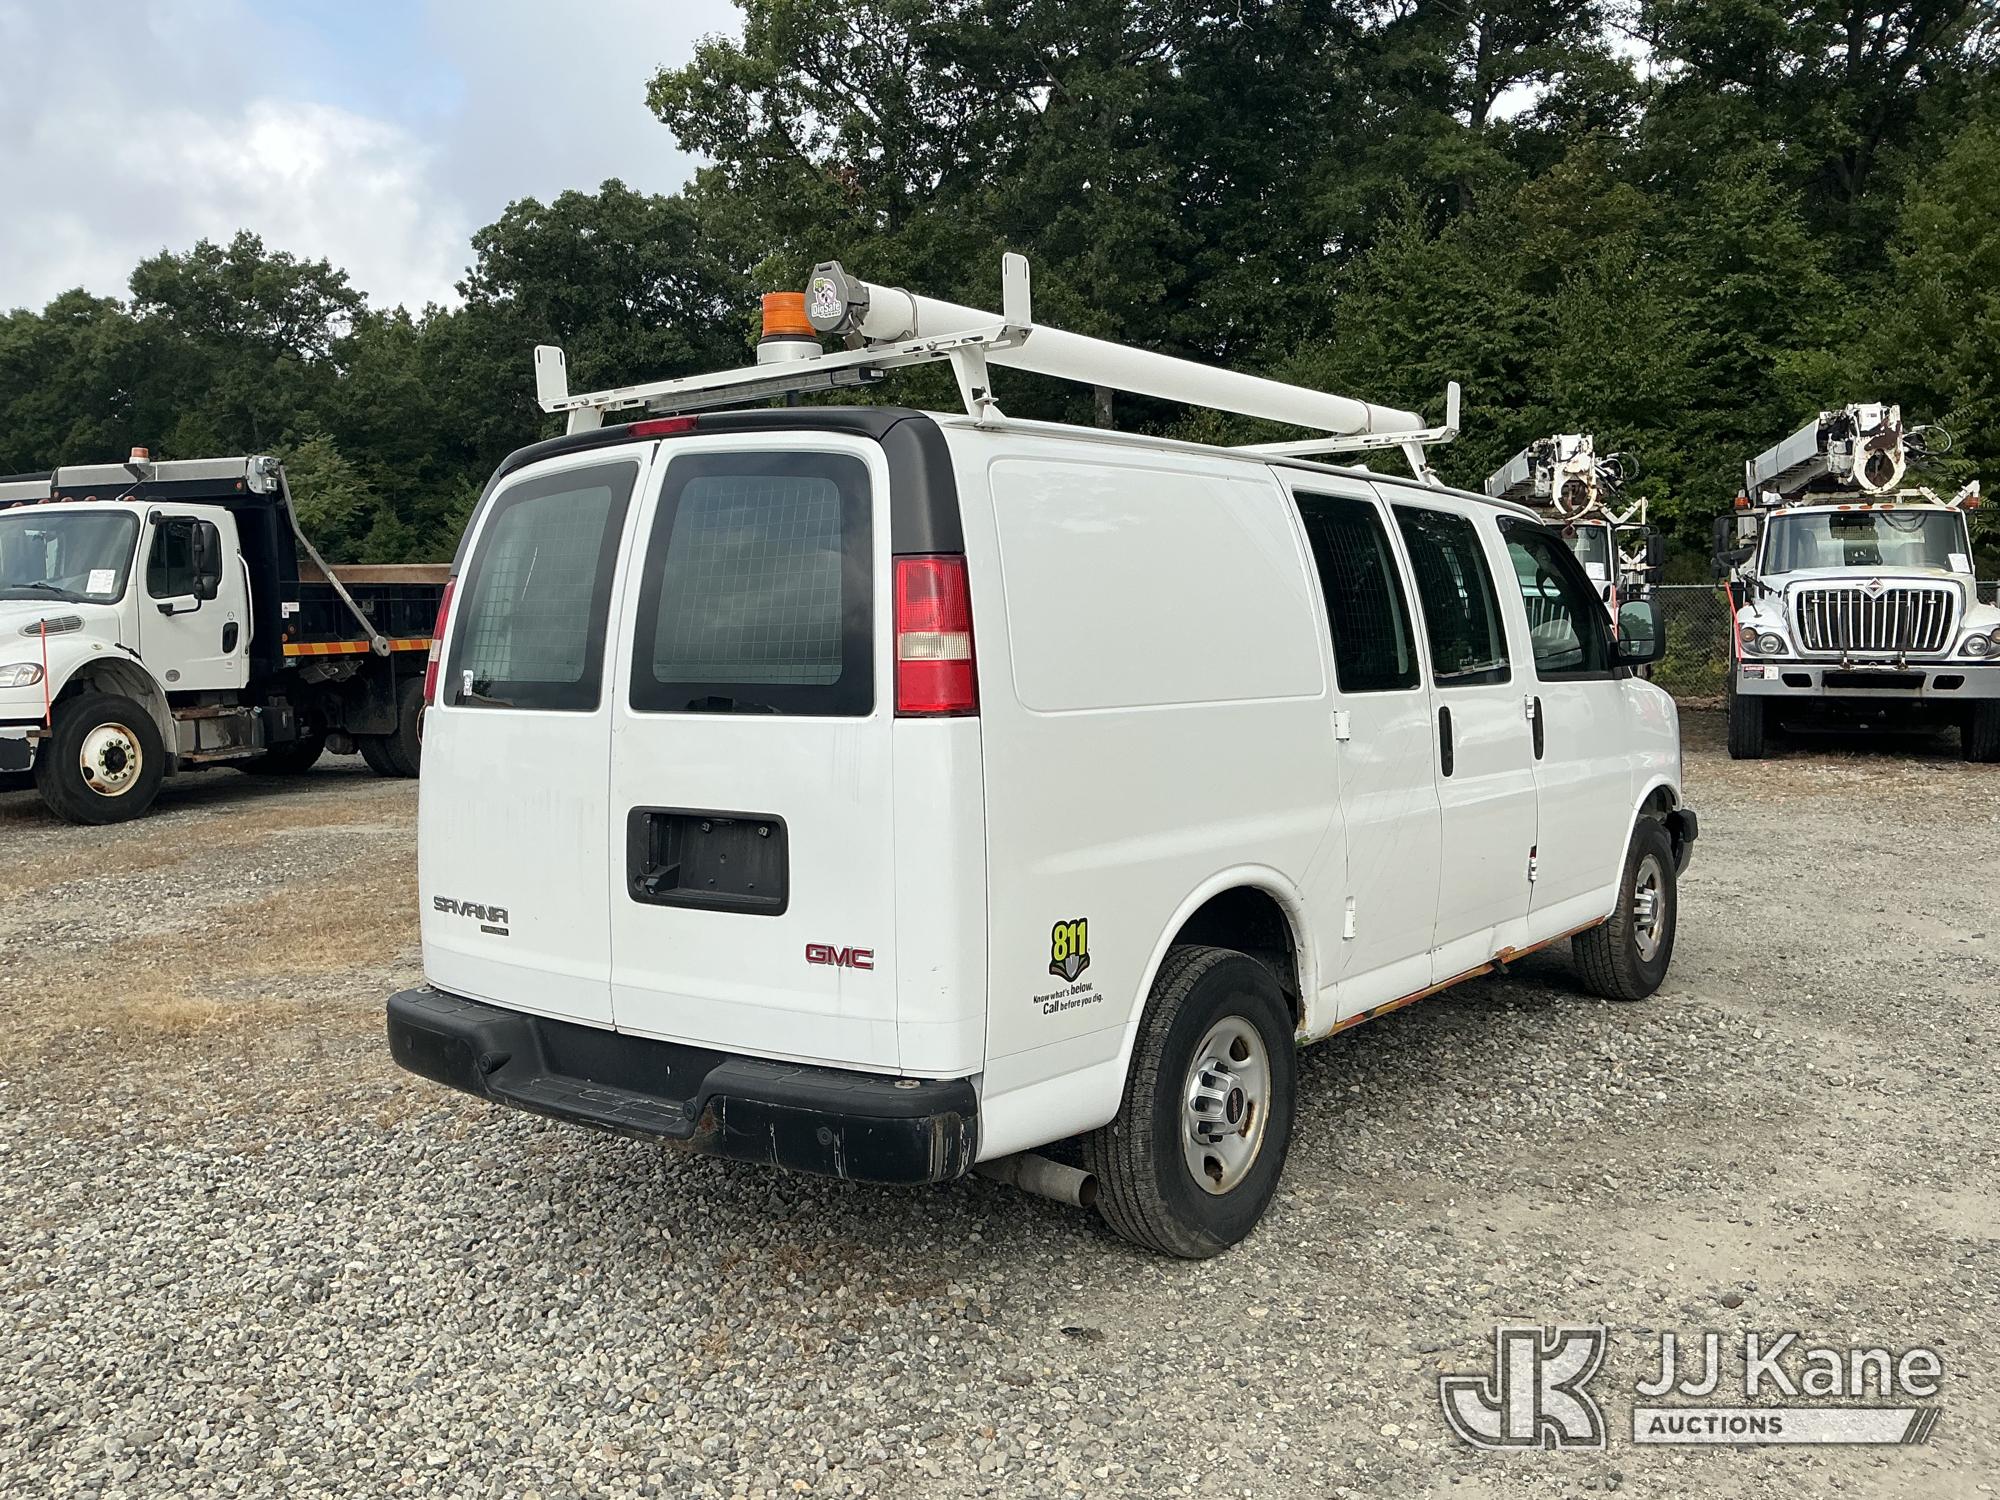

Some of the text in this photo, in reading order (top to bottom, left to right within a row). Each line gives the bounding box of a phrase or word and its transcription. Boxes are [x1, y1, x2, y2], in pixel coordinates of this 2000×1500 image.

[433, 895, 509, 924] SAVANA
[1052, 918, 1087, 961] 811
[805, 943, 875, 970] GMC
[1033, 982, 1093, 1004] Know what's below.
[1043, 1000, 1059, 1015] Call
[1060, 999, 1081, 1011] before
[1081, 996, 1092, 1008] you
